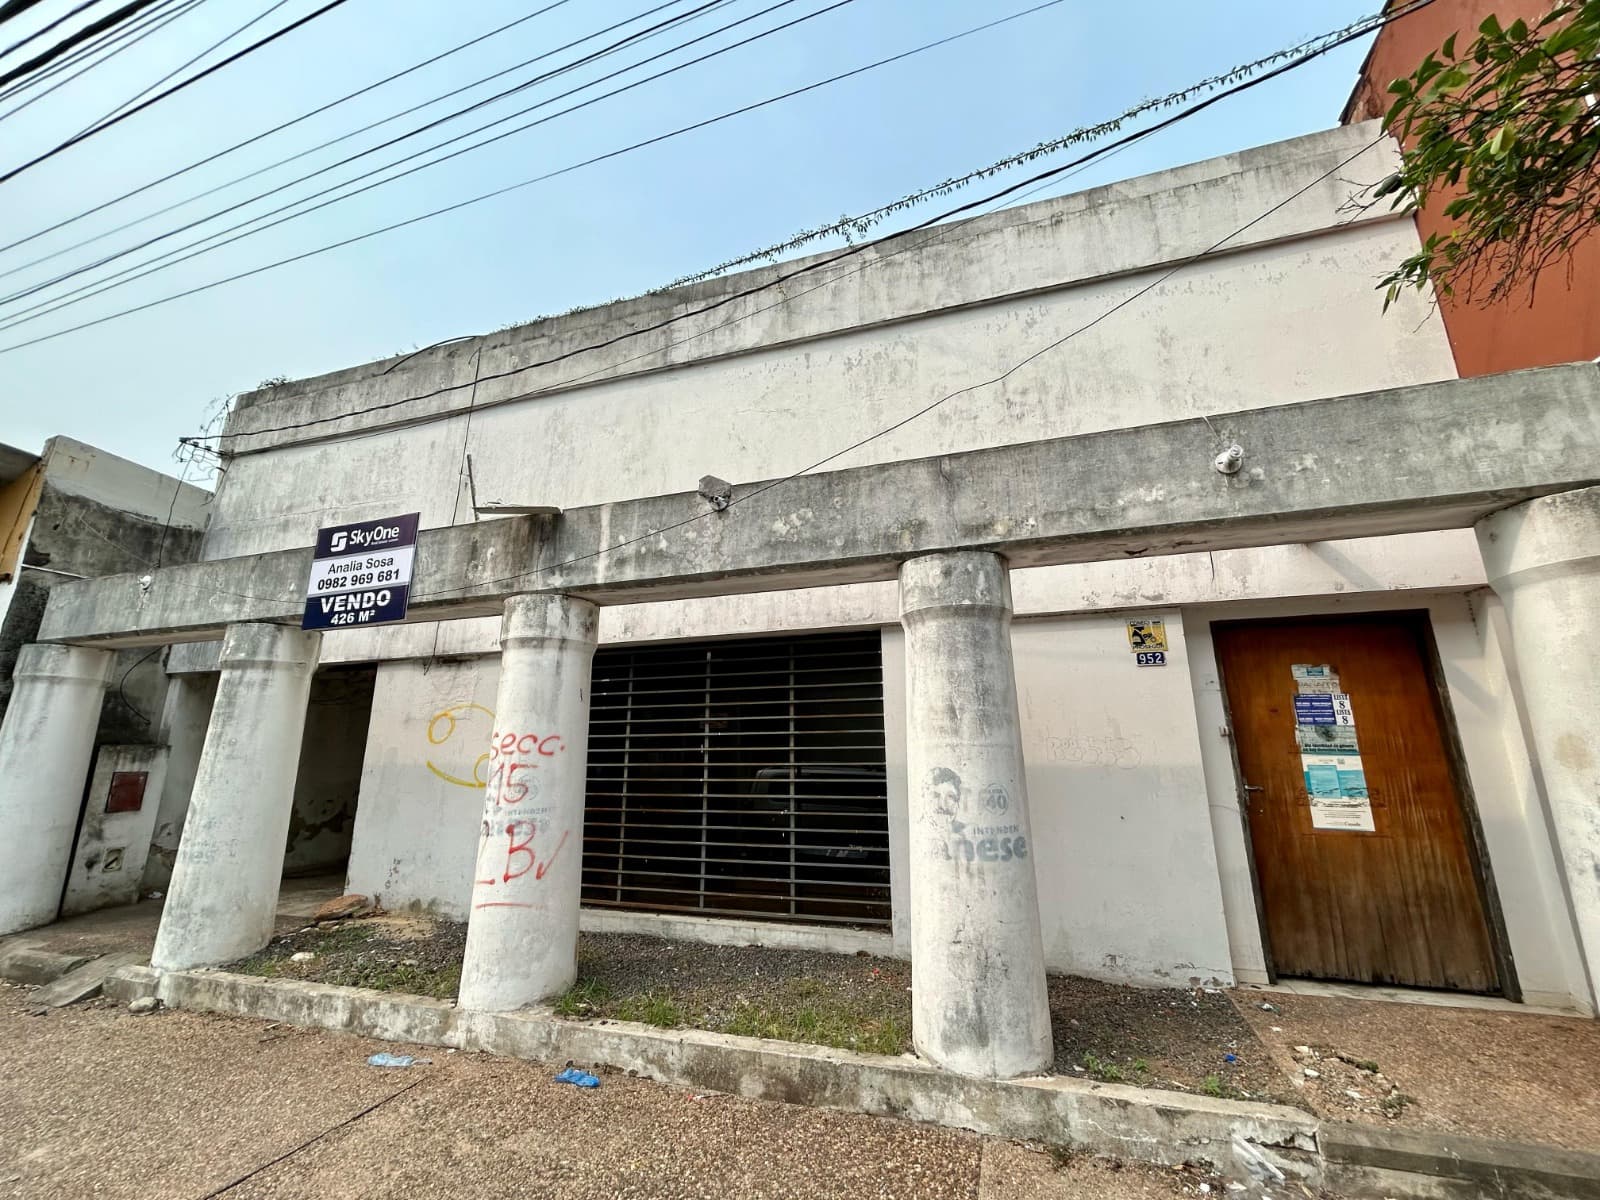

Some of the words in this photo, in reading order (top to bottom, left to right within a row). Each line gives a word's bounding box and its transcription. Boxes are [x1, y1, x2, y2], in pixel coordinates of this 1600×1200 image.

[350, 526, 400, 546] SkyOne
[366, 557, 394, 570] Sosa
[317, 577, 348, 590] 0982
[350, 573, 373, 586] 969
[377, 569, 400, 582] 681
[321, 590, 391, 613] VENDO
[330, 613, 355, 624] 426
[1139, 653, 1162, 664] 952
[1339, 701, 1346, 709] 8
[1342, 716, 1349, 724] 8
